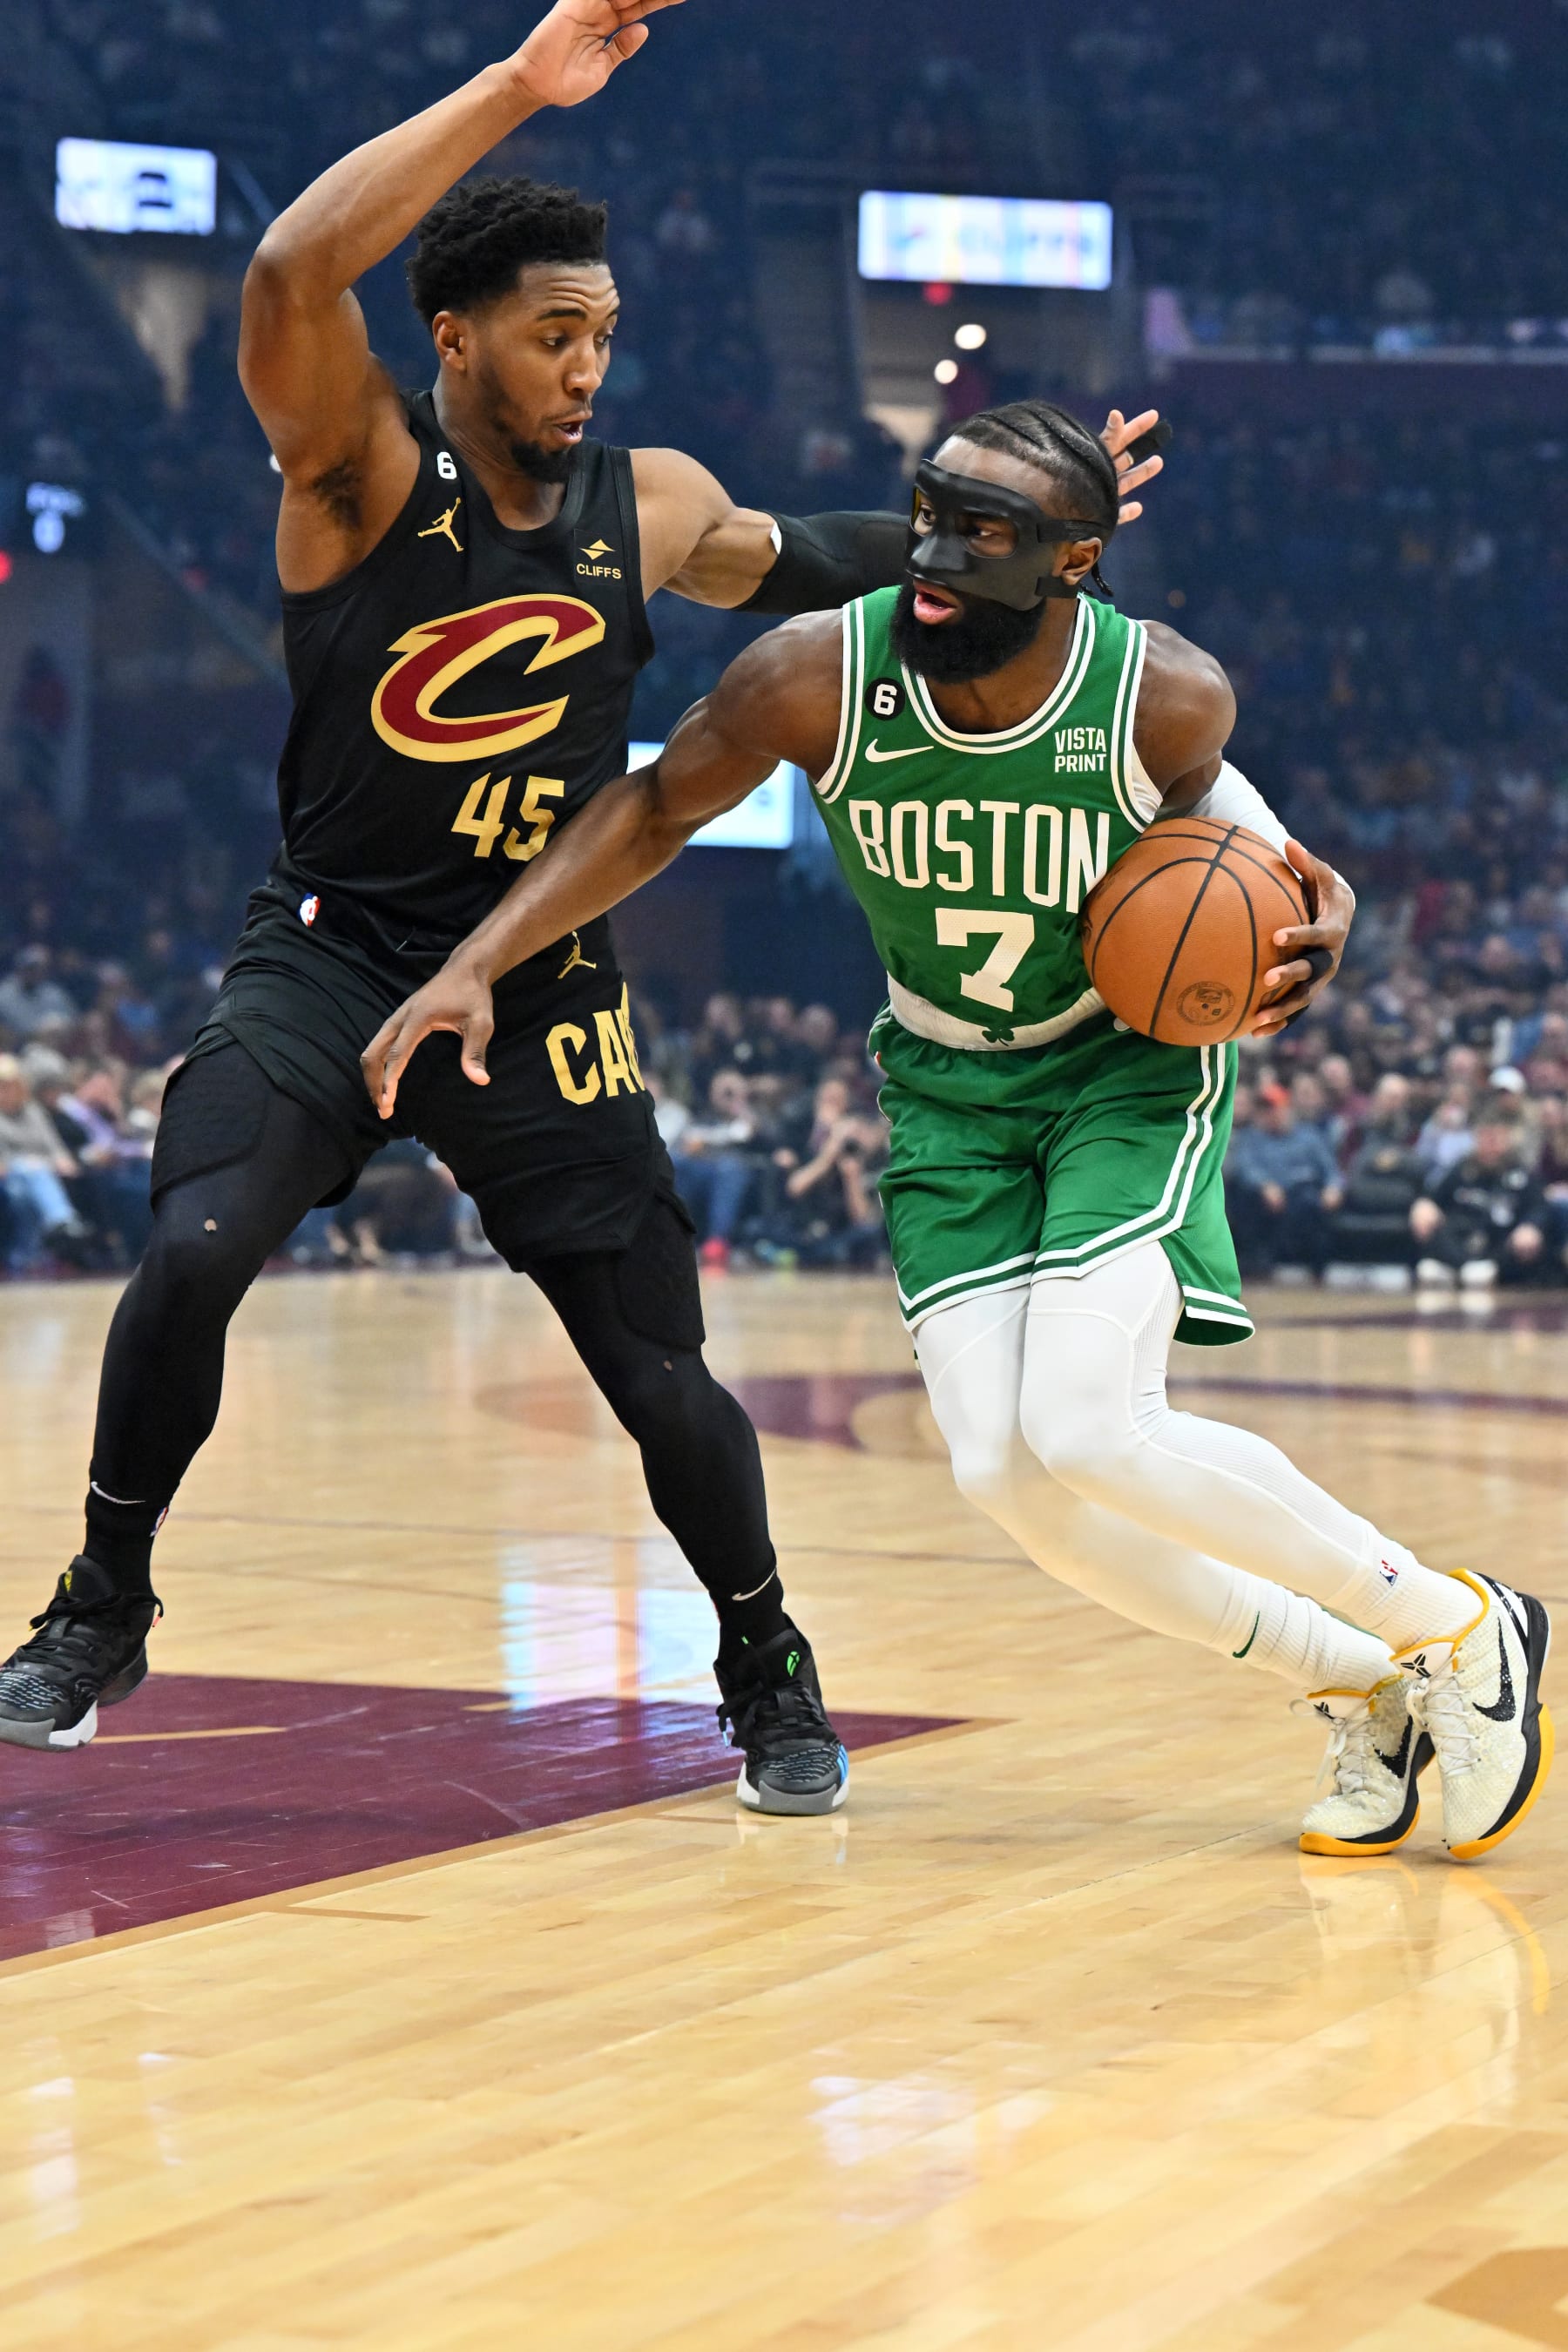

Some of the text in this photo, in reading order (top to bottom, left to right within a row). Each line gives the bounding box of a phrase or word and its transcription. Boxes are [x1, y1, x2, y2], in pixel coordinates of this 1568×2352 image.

[436, 451, 457, 480] 6
[576, 563, 622, 579] CLIFFS
[370, 593, 606, 763] C
[873, 683, 897, 716] 6
[1054, 727, 1107, 754] VISTA
[1054, 754, 1107, 774] PRINT
[450, 772, 565, 862] 45
[848, 799, 1110, 914] BOSTON
[935, 908, 1035, 1012] 7
